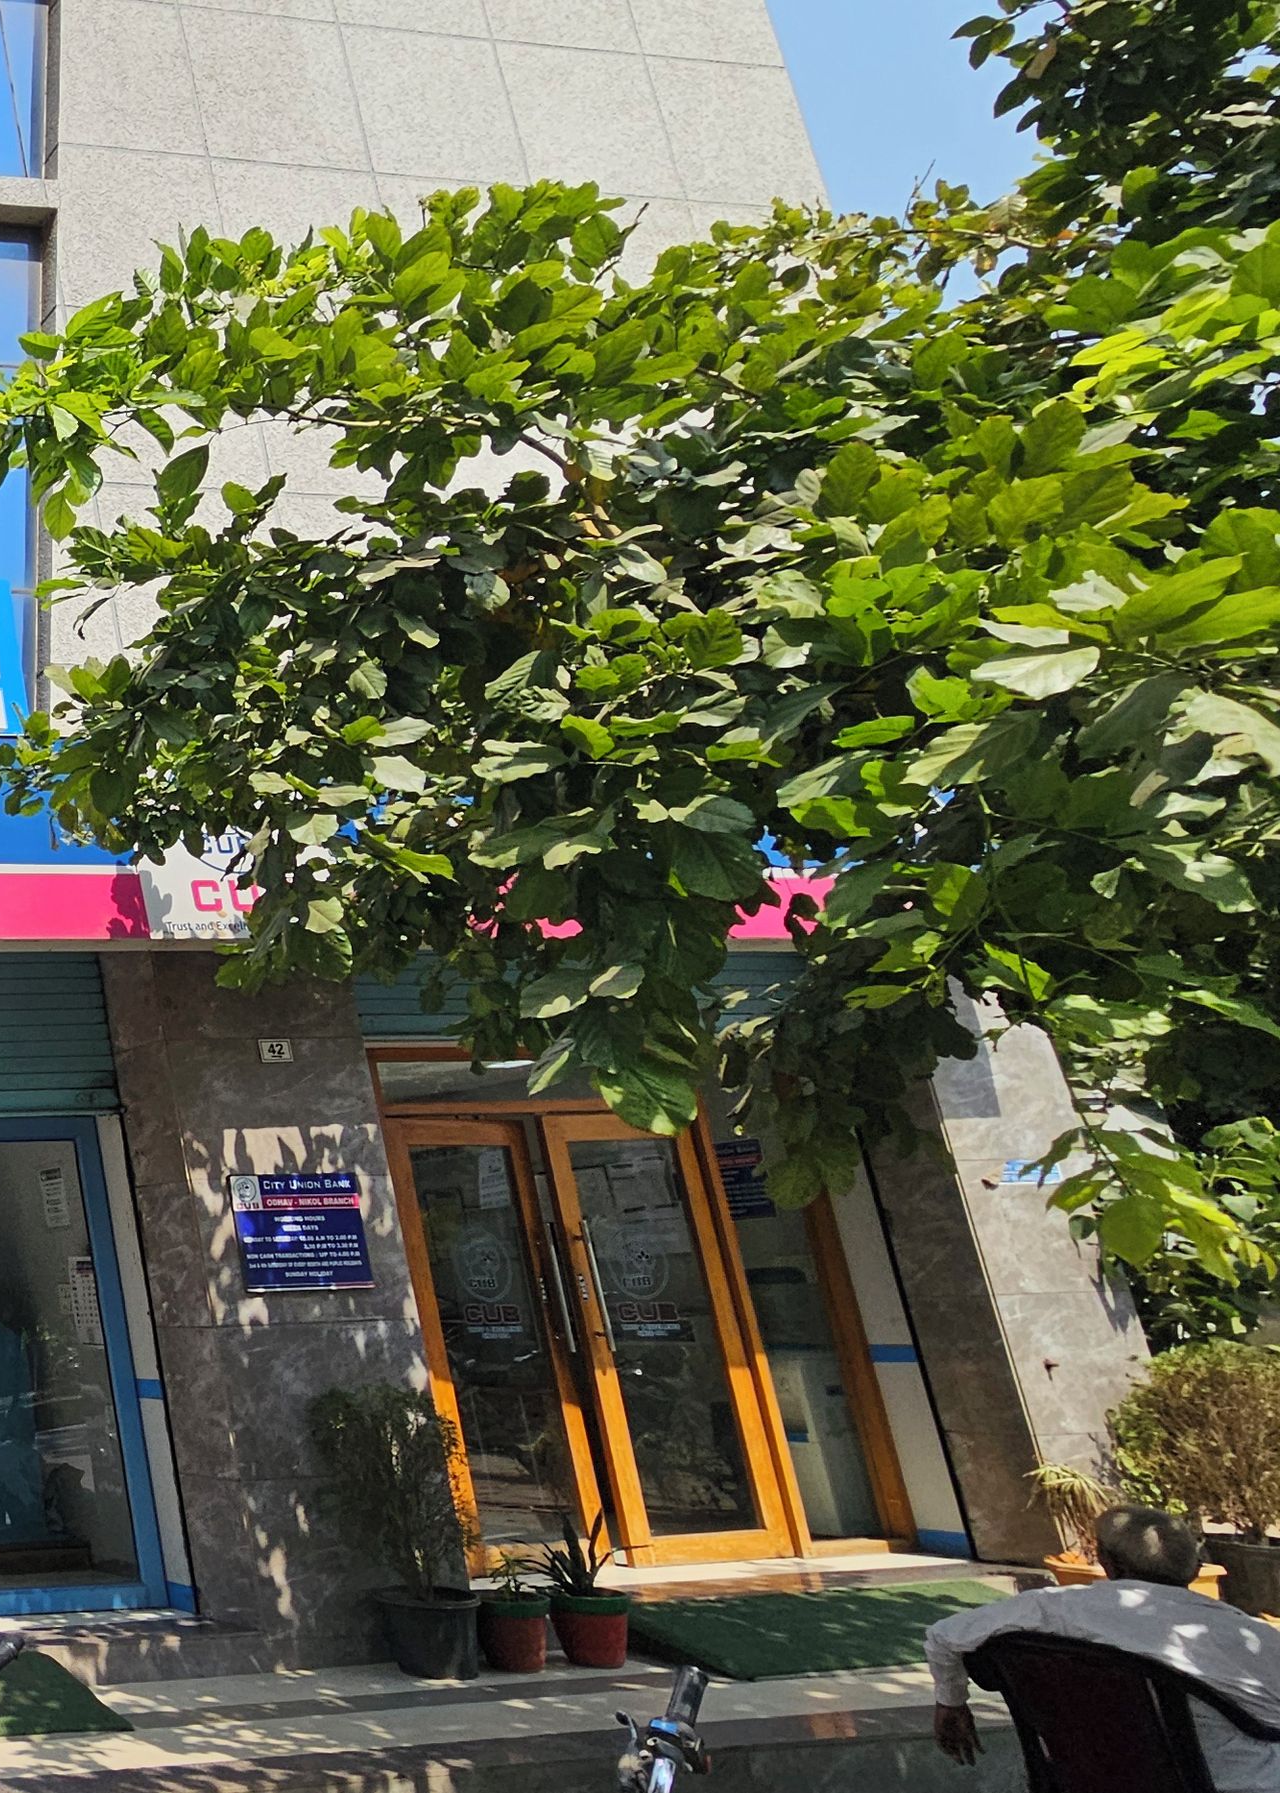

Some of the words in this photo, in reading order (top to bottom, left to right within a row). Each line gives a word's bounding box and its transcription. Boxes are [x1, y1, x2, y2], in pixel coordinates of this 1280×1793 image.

[167, 921, 193, 931] Trust
[195, 921, 214, 931] and
[267, 1043, 285, 1055] 42
[464, 1304, 521, 1323] CUB
[617, 1302, 678, 1322] CUB
